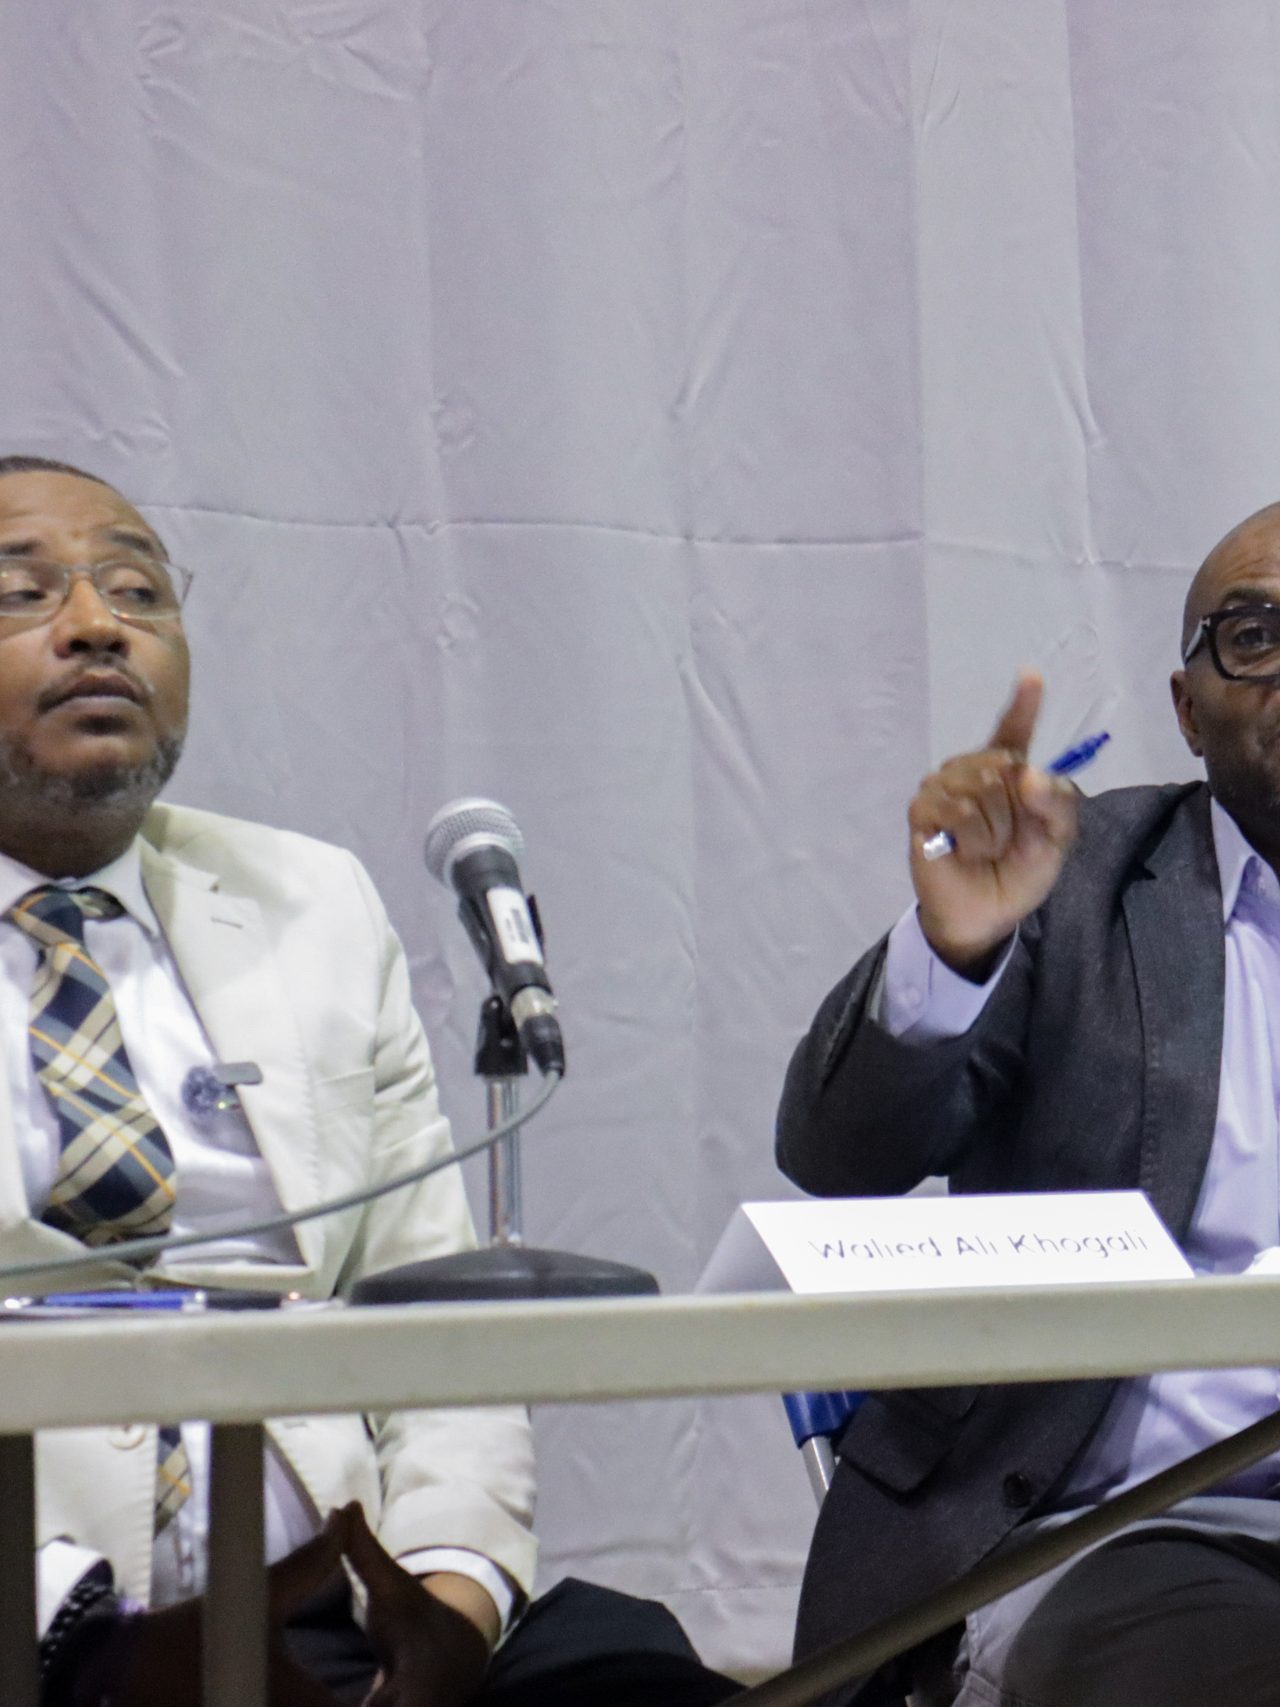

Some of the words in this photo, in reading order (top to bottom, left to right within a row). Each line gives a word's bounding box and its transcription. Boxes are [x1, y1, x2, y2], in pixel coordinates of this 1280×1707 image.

[808, 1237, 942, 1260] Walied
[956, 1234, 998, 1256] Ali
[1007, 1230, 1149, 1258] Khogali
